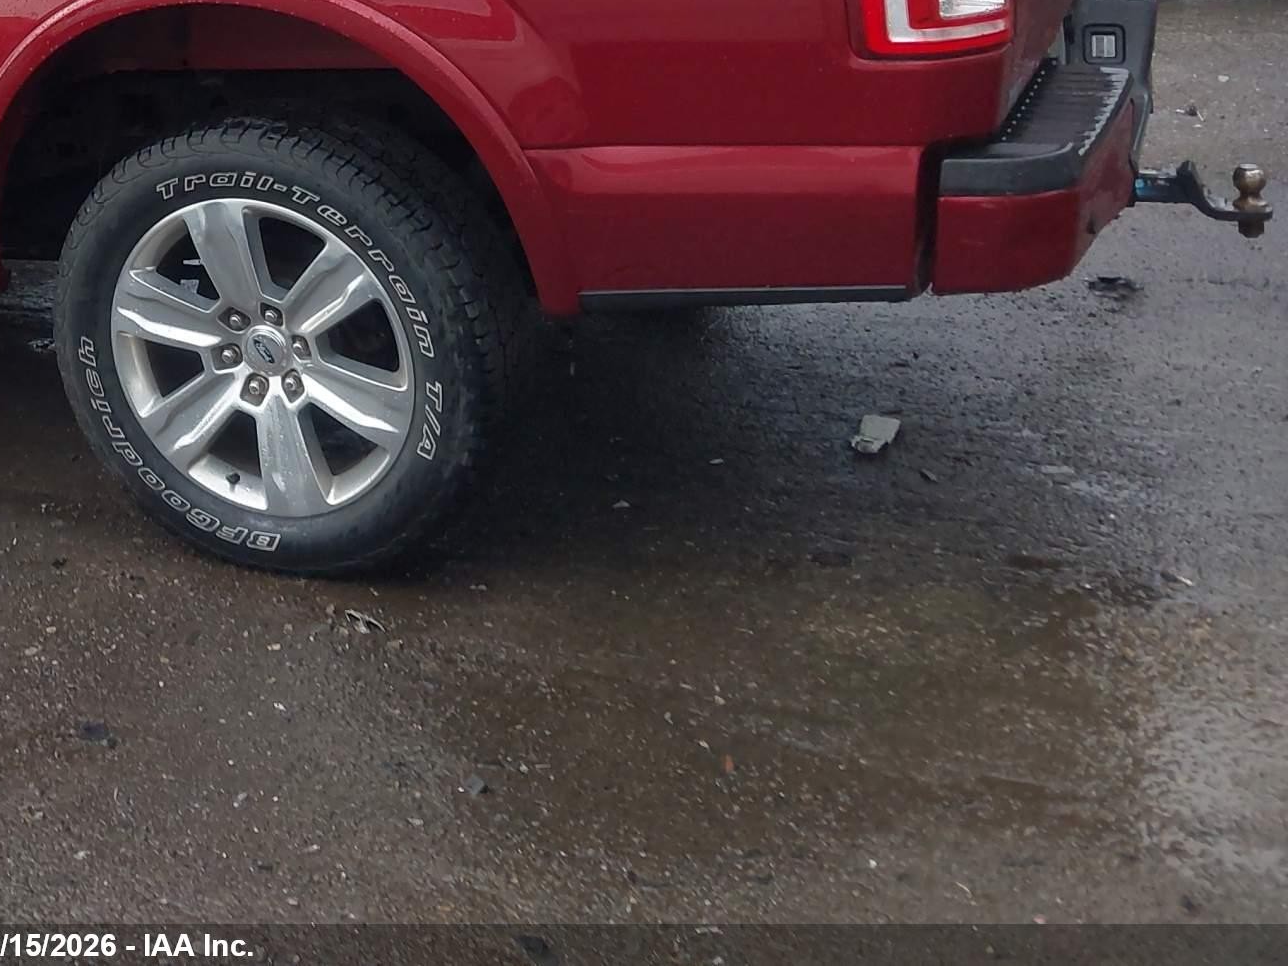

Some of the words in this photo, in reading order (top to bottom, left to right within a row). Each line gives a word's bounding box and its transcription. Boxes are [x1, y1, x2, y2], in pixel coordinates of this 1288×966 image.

[155, 170, 436, 359] Trail-Terrain
[77, 335, 282, 553] BFGoodrich
[416, 380, 444, 460] T/A
